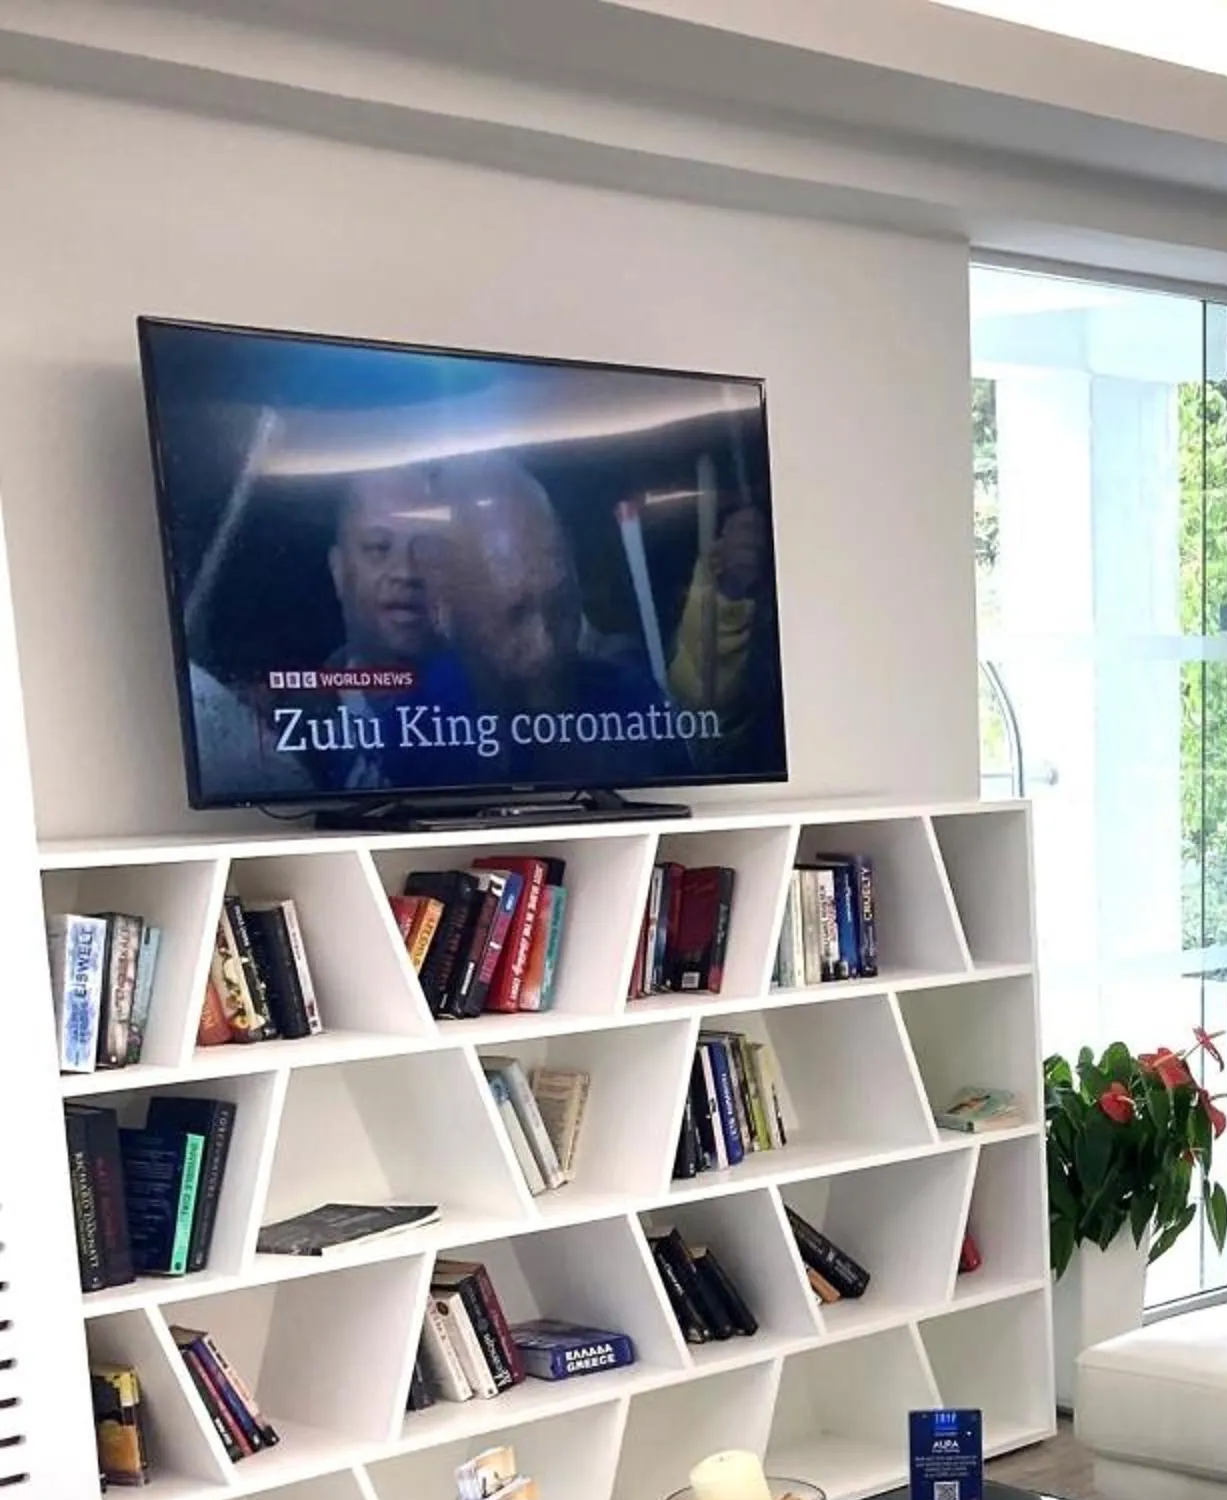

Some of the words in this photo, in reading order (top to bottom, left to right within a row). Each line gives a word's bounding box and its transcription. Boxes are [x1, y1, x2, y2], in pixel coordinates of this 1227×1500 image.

[270, 671, 317, 689] BBC
[320, 672, 371, 687] WORLD
[373, 672, 413, 686] NEWS
[274, 706, 384, 751] Zulu
[396, 705, 500, 756] King
[512, 702, 722, 744] coronation
[74, 926, 93, 998] EISWELT
[566, 1353, 616, 1373] GREECE
